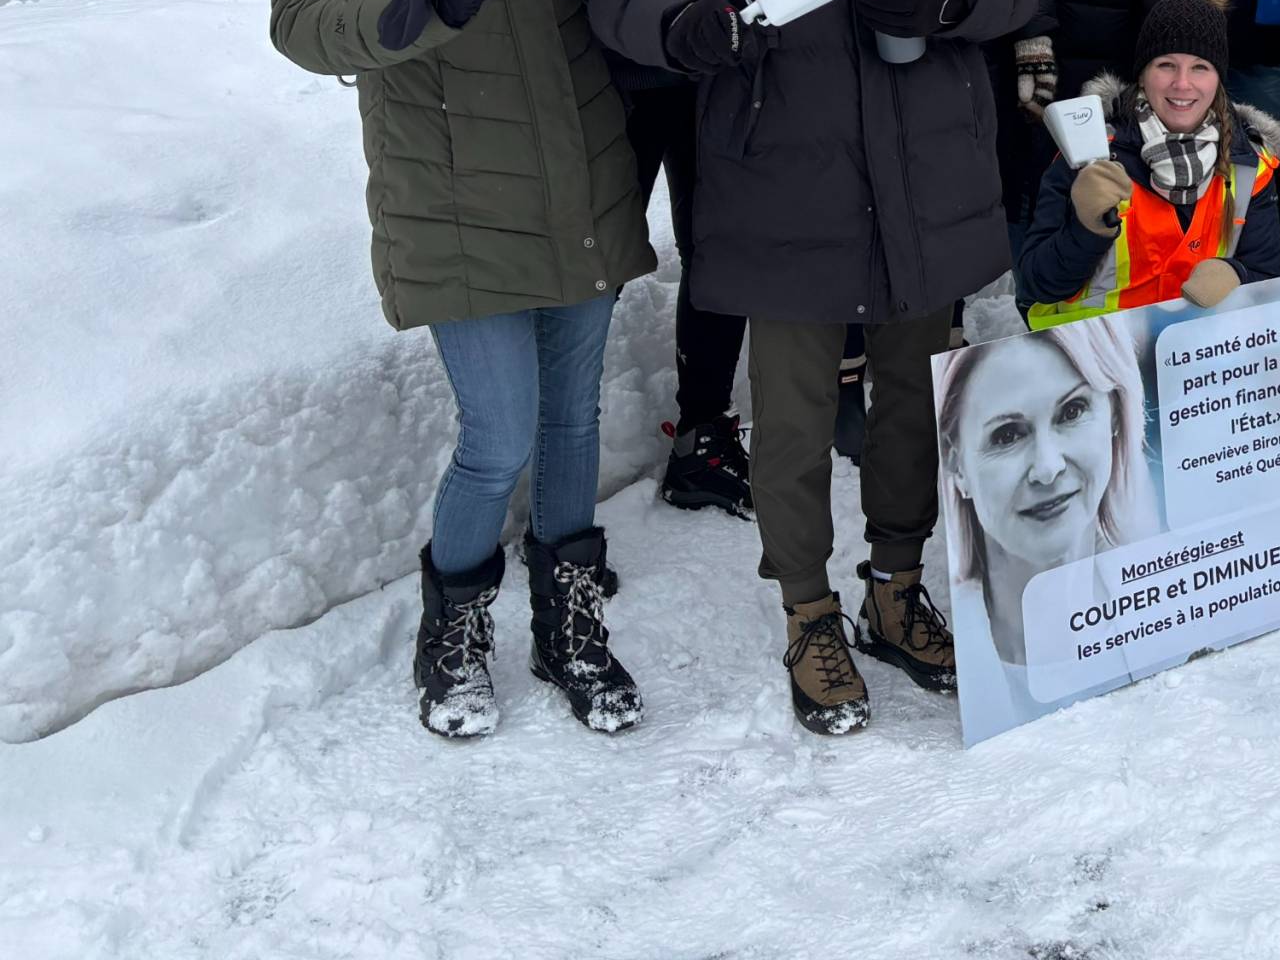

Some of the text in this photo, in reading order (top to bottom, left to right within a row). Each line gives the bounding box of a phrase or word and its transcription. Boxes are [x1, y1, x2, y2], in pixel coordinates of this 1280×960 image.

[1196, 336, 1241, 360] santé
[1246, 329, 1278, 349] doit
[1183, 370, 1217, 395] part
[1222, 362, 1259, 385] pour
[1264, 356, 1278, 371] la
[1169, 397, 1232, 426] gestion
[1216, 463, 1253, 483] Santé
[1121, 531, 1244, 582] Montérégie-est
[1069, 586, 1160, 632] COUPER
[1166, 578, 1188, 599] et
[1077, 642, 1101, 660] les
[1105, 616, 1172, 650] services
[1176, 609, 1186, 625] à
[1190, 605, 1204, 621] la
